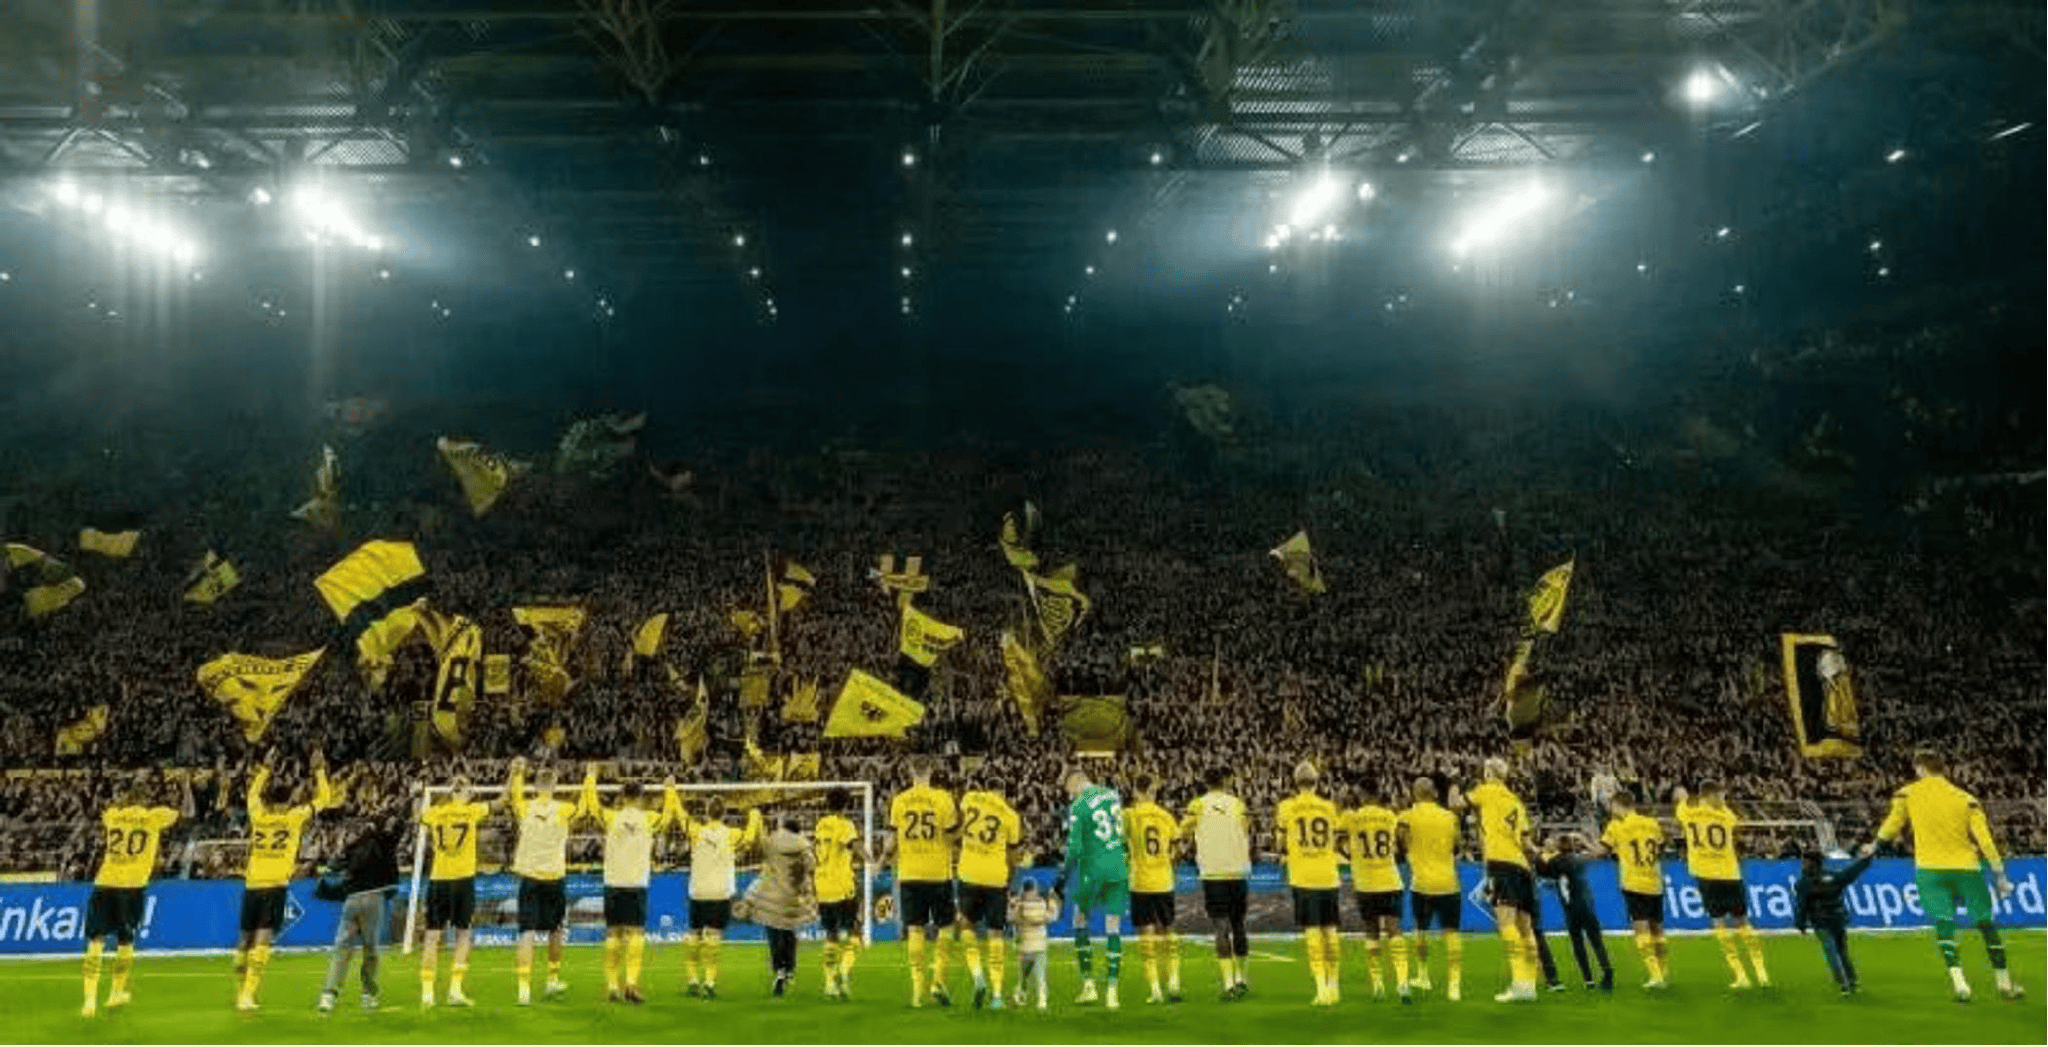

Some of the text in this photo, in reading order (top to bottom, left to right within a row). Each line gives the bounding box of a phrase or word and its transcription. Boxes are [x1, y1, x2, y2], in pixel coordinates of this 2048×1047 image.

[904, 810, 935, 840] 25
[964, 806, 1001, 844] 23
[1296, 816, 1329, 848] 19
[1504, 808, 1518, 831] 4
[108, 828, 148, 856] 20
[254, 830, 290, 850] 22
[436, 822, 469, 851] 17
[1145, 825, 1160, 855] 6
[1358, 830, 1390, 858] 18
[1688, 821, 1726, 849] 10
[1629, 838, 1657, 867] 13
